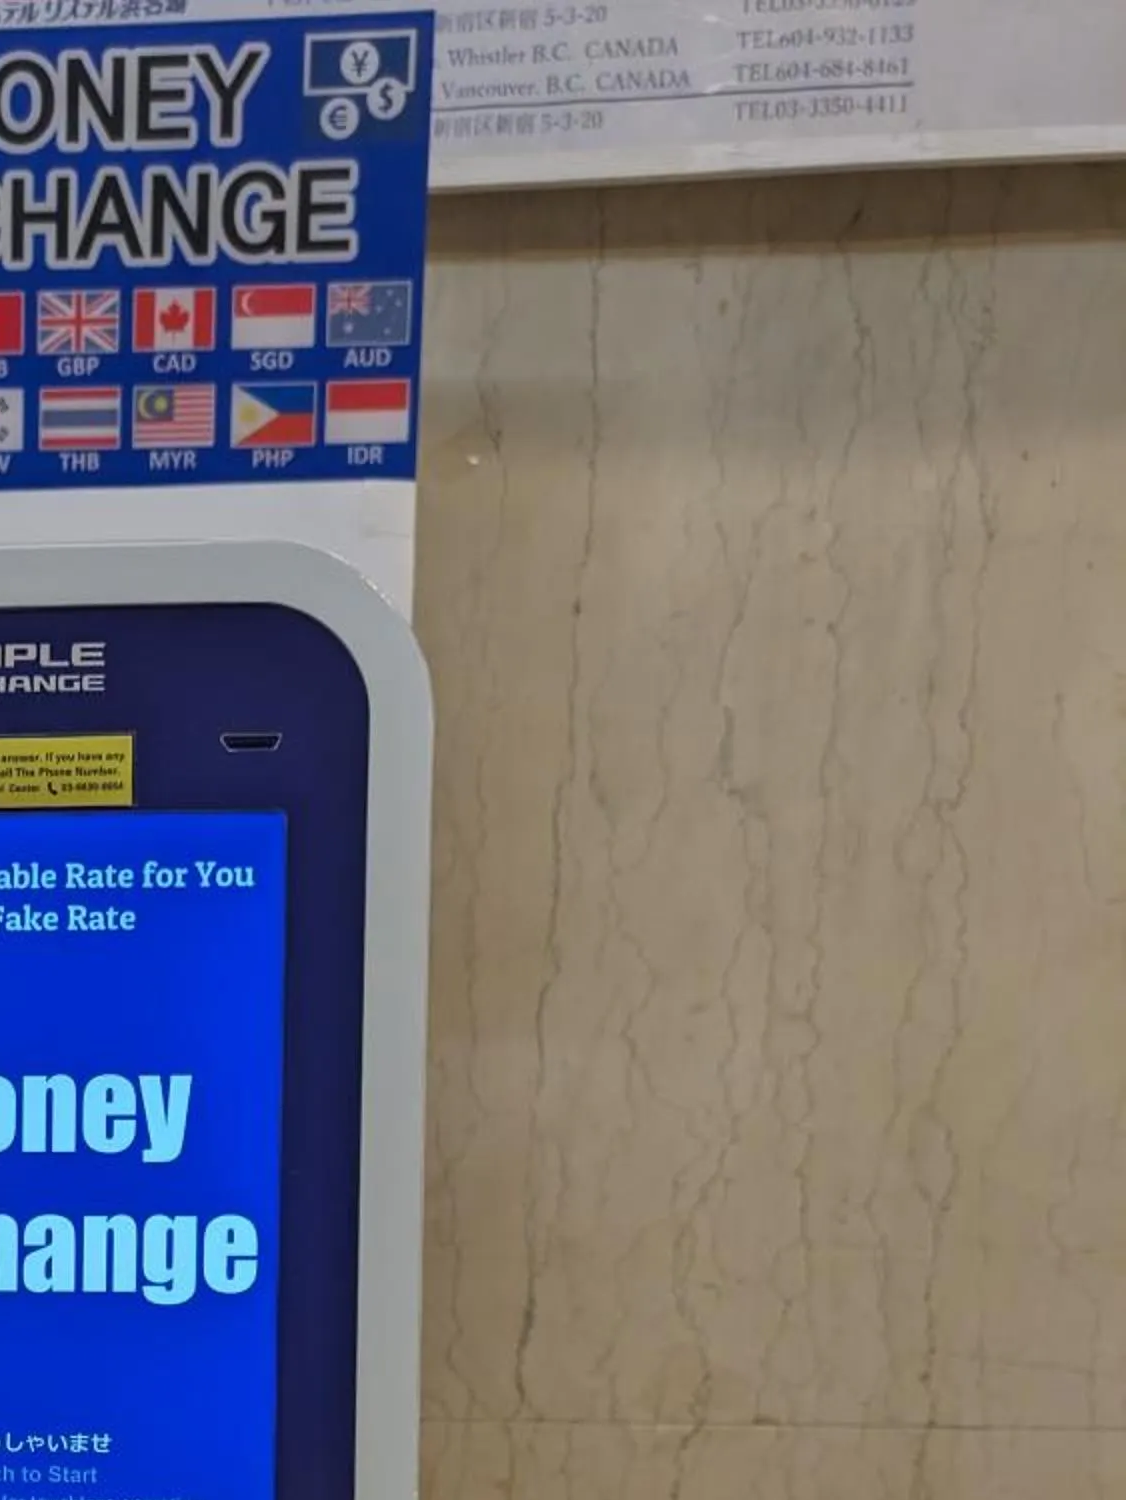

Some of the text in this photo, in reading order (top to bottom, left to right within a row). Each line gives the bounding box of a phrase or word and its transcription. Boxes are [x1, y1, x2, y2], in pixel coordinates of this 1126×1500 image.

[448, 46, 525, 68] Whistler
[584, 37, 679, 60] CANADA
[595, 71, 692, 92] CANADA
[57, 357, 99, 376] GBP
[153, 354, 196, 373] CAD
[250, 352, 293, 370] SGD
[344, 349, 391, 368] AUD
[59, 452, 99, 471] THB
[150, 451, 196, 470] MYR
[252, 450, 294, 467] PHP
[347, 447, 383, 465] IDR
[1, 754, 42, 764] answer.
[45, 752, 53, 762] If
[55, 754, 75, 765] you
[77, 752, 103, 761] have
[105, 753, 125, 763] any
[64, 863, 134, 889] Rate
[141, 861, 187, 888] for
[195, 861, 256, 887] You
[67, 905, 136, 930] Rate
[23, 1466, 41, 1483] to
[47, 1466, 98, 1484] Start
